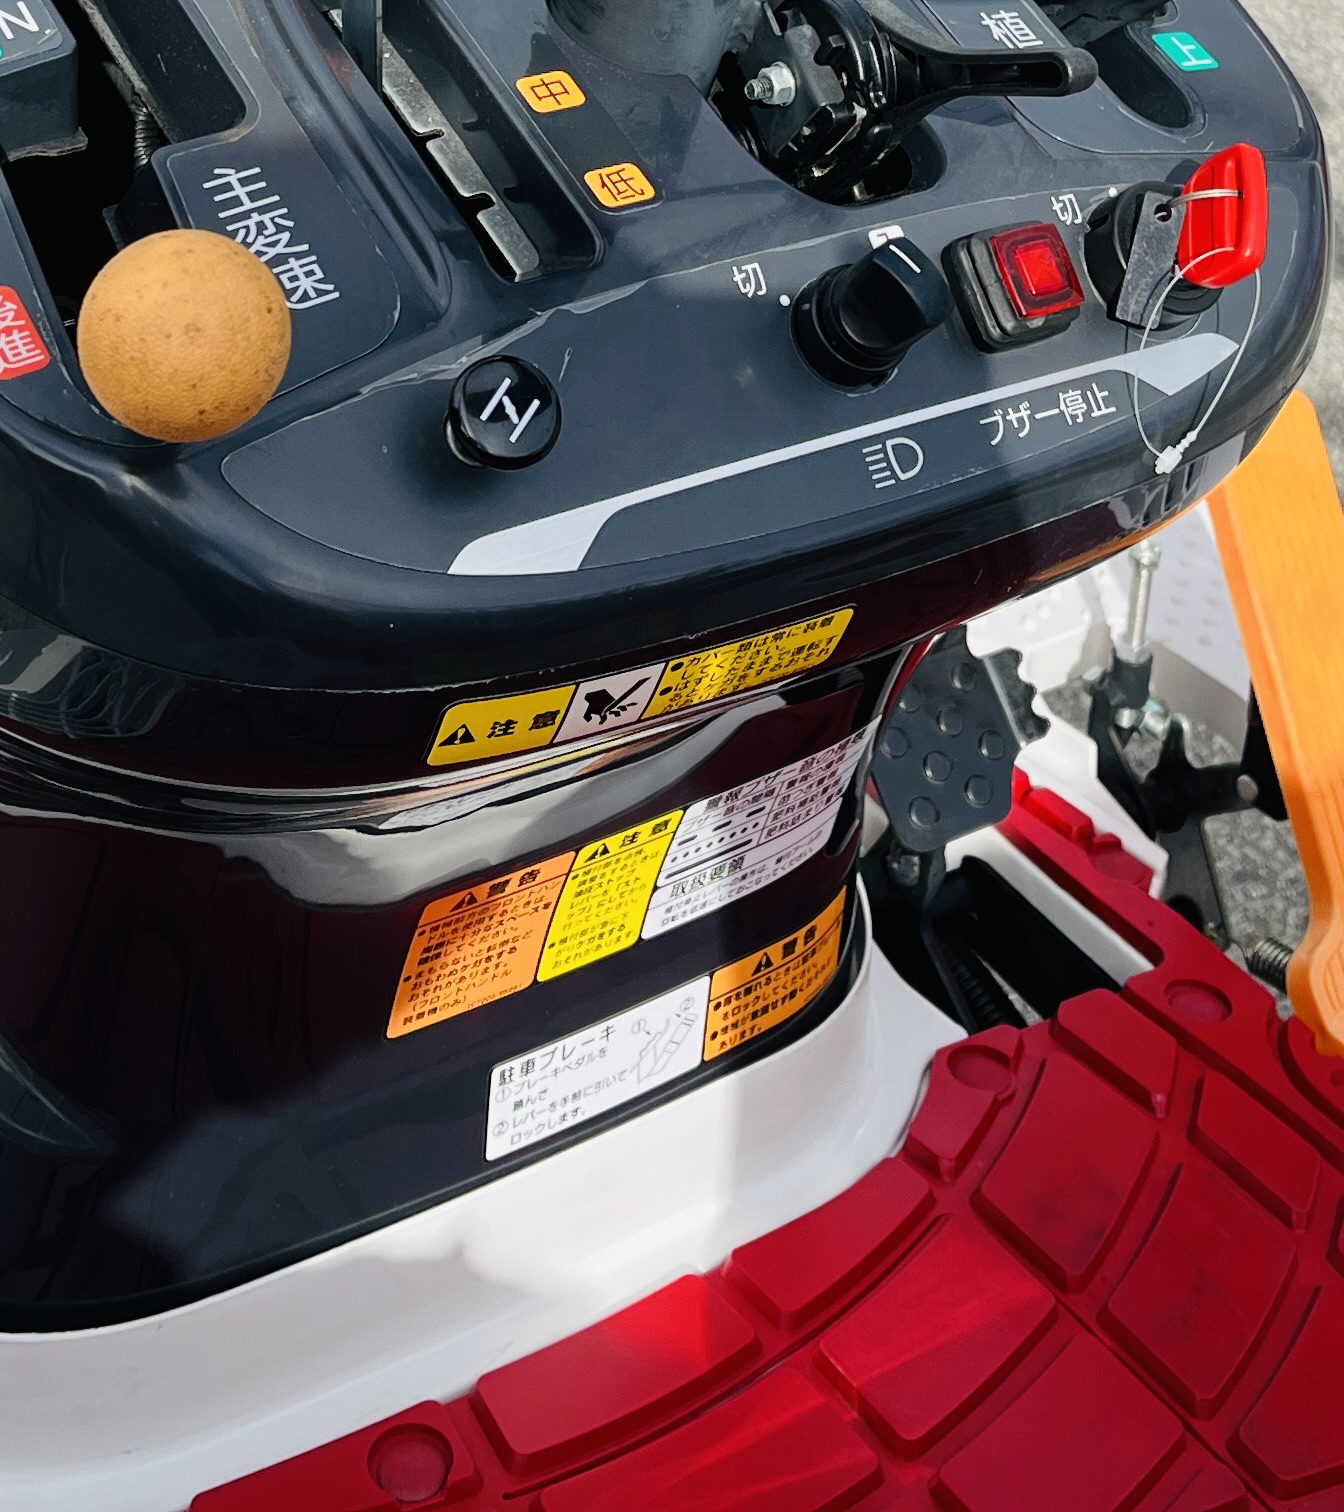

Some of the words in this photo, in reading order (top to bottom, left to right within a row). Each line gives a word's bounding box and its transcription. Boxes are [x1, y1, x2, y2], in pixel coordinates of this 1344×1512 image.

[1164, 35, 1212, 69] 上
[531, 76, 573, 108] 中
[597, 168, 646, 202] 低
[1052, 191, 1084, 228] 切
[202, 166, 340, 310] 主変速
[732, 261, 768, 299] 切
[979, 382, 1117, 446] ブザー停止
[487, 709, 559, 740] 注意
[618, 817, 671, 849] 注意
[498, 1022, 616, 1088] 駐車ブレーキ
